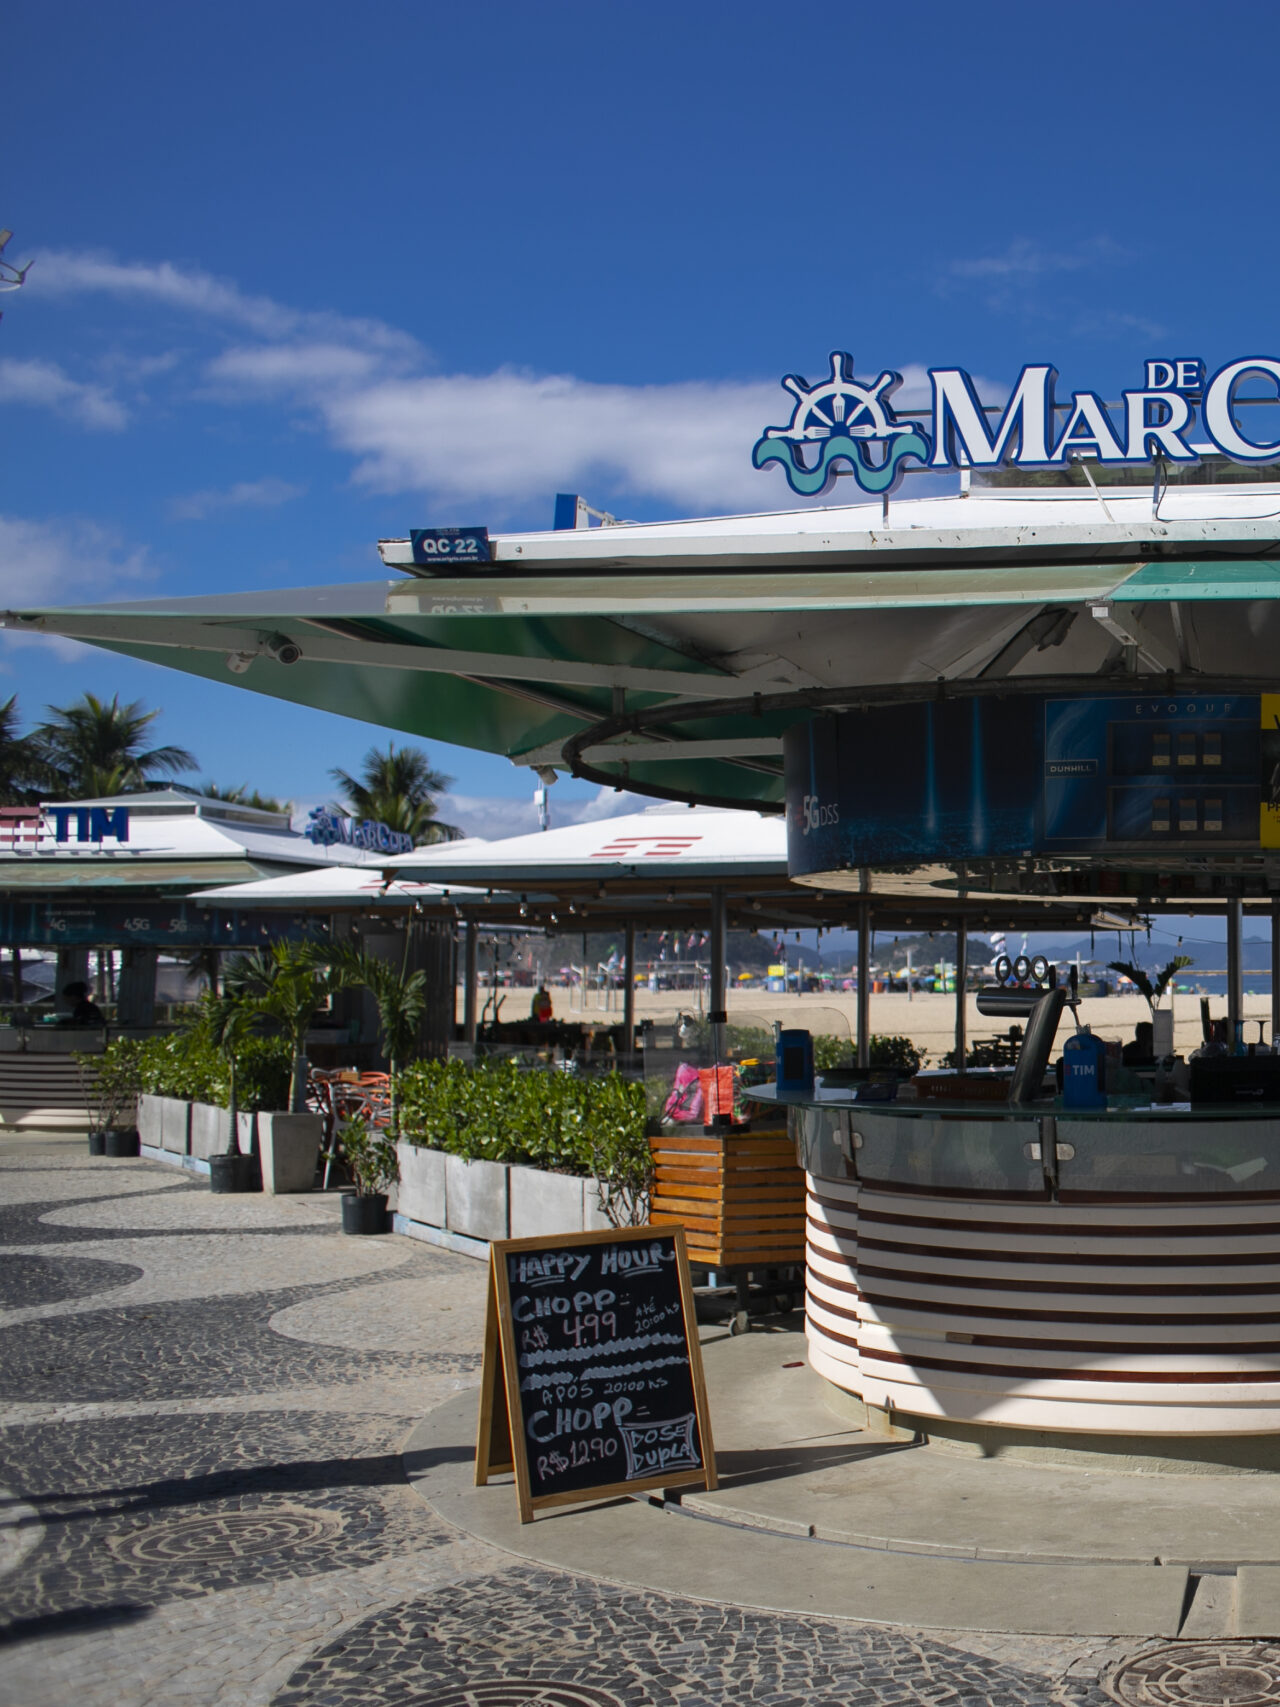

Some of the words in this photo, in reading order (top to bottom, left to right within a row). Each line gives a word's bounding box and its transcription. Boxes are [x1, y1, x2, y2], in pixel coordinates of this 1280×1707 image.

[1146, 358, 1204, 394] DE
[423, 538, 450, 554] QC
[454, 538, 478, 554] 22
[1136, 703, 1232, 715] EVOQUE
[1049, 764, 1091, 773] DUNHILL
[48, 806, 130, 842] TIM
[802, 795, 820, 836] 5G
[820, 803, 840, 826] DSS
[49, 917, 66, 932] 4G
[1072, 1064, 1095, 1076] TIM
[510, 1252, 591, 1283] HAPPY
[601, 1242, 675, 1275] HOUR
[512, 1289, 616, 1322] CHOPP
[521, 1324, 549, 1350] R$
[527, 1396, 633, 1443] CHOPP
[631, 1424, 687, 1448] DOSE
